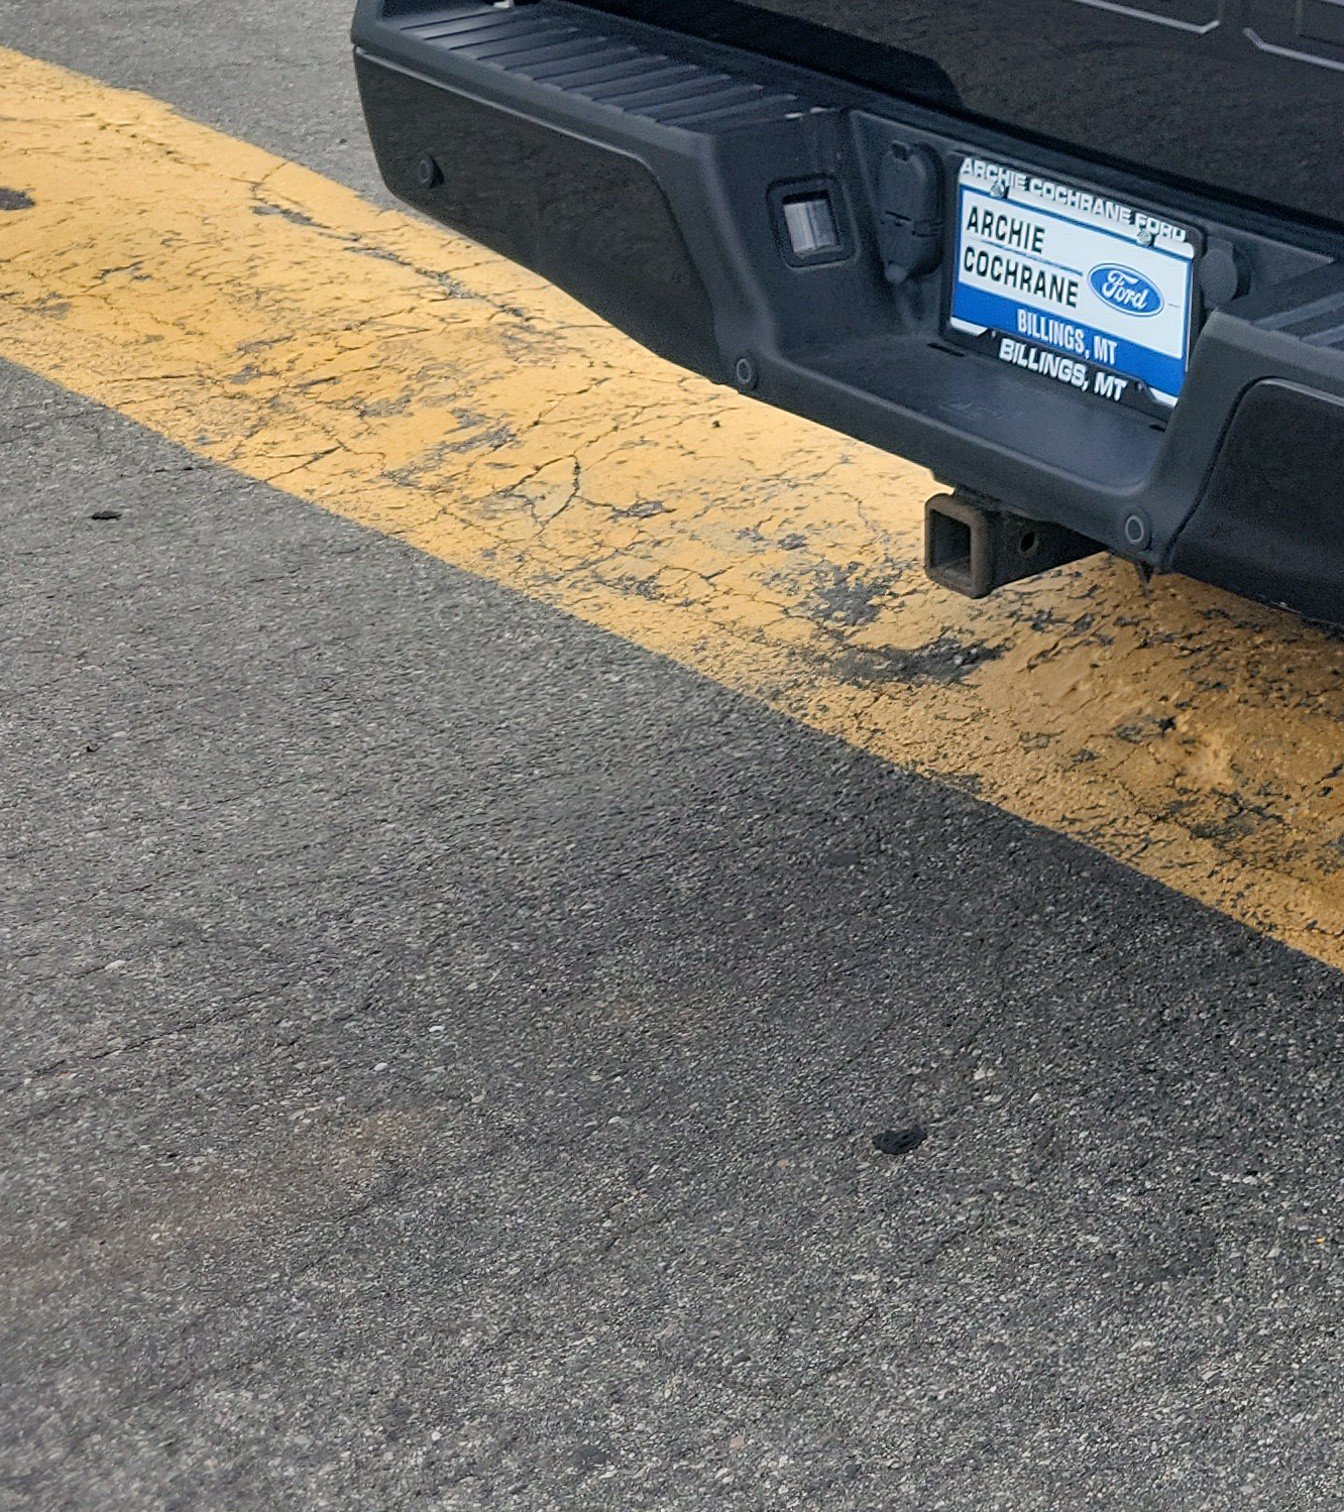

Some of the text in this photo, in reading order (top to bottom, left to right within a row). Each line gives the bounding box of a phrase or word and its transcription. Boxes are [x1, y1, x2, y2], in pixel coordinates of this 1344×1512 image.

[961, 157, 1027, 191] ARCHIE
[1029, 177, 1131, 226] COCHRANE
[966, 205, 1046, 255] ARCHIE
[963, 245, 1080, 309] COCHRANE
[1100, 269, 1150, 310] Ford
[1016, 308, 1119, 366] BILLINGS, MT
[998, 337, 1128, 403] BILLINGS, MT
